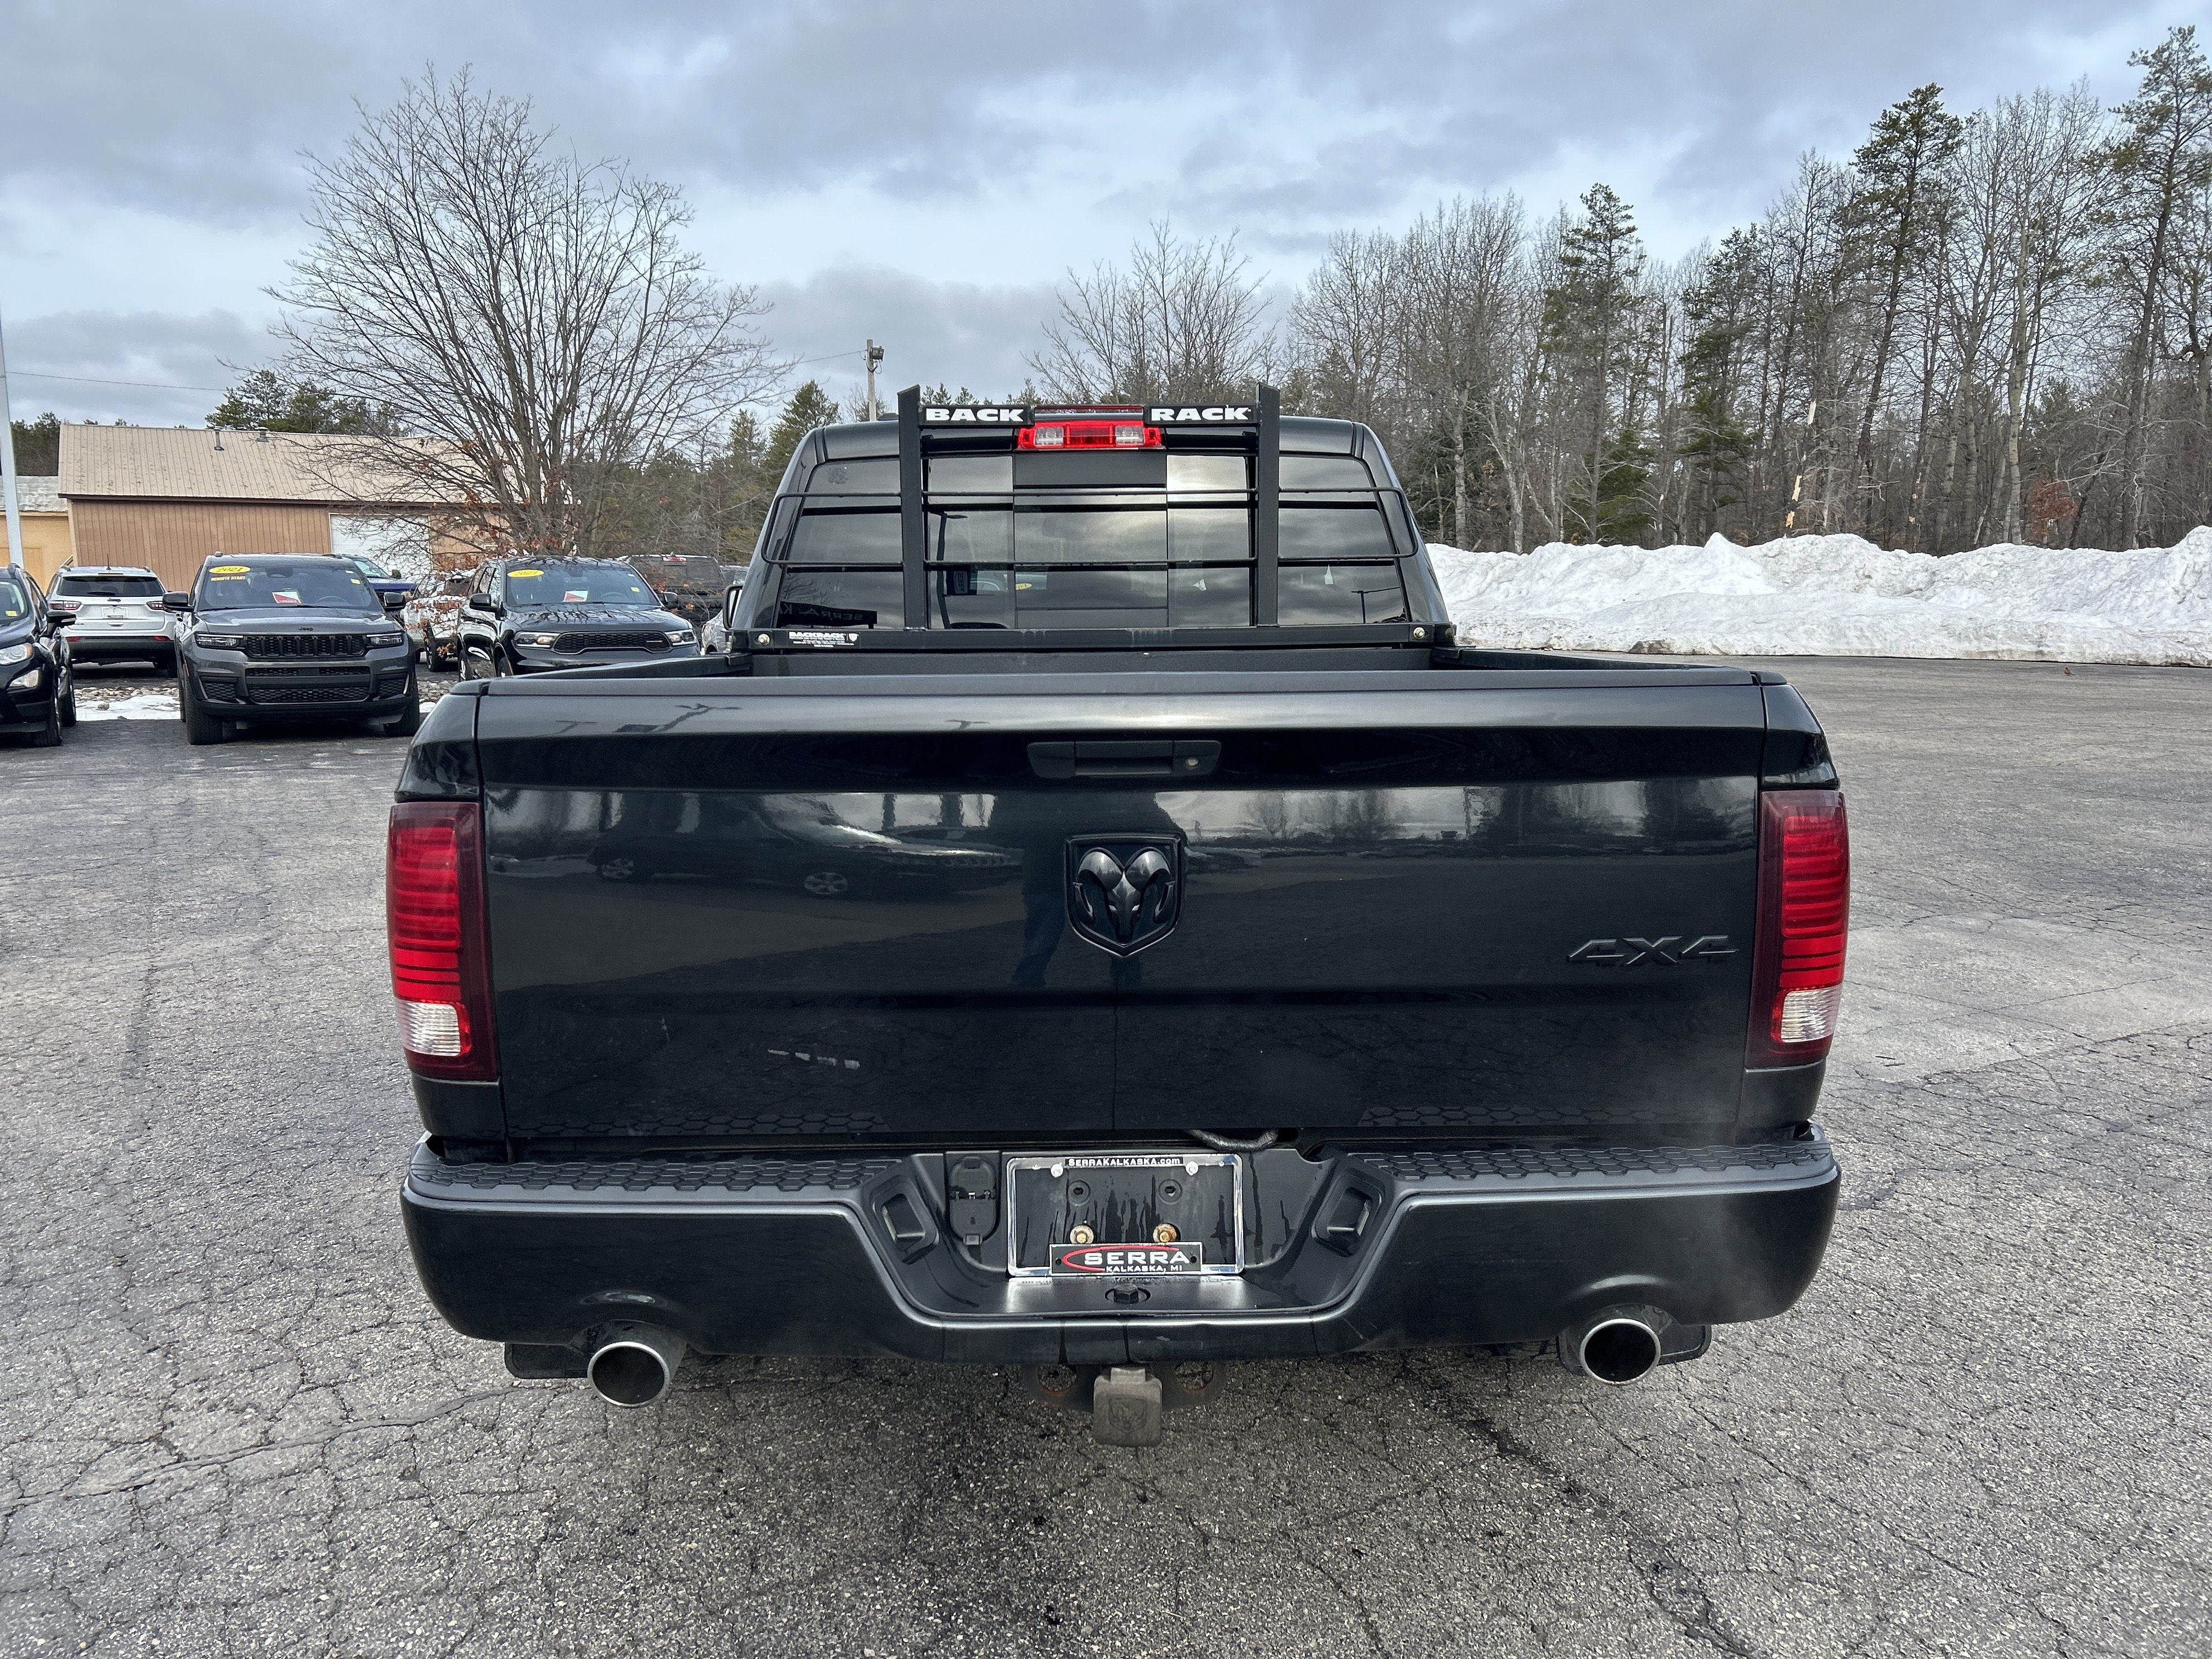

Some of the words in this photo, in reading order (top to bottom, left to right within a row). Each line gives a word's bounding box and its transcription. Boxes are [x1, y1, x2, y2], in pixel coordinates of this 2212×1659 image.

[926, 408, 1024, 422] BACK
[1151, 408, 1249, 421] RACK
[1084, 1251, 1190, 1265] SERRA
[1106, 1265, 1167, 1273] KALKASKA,
